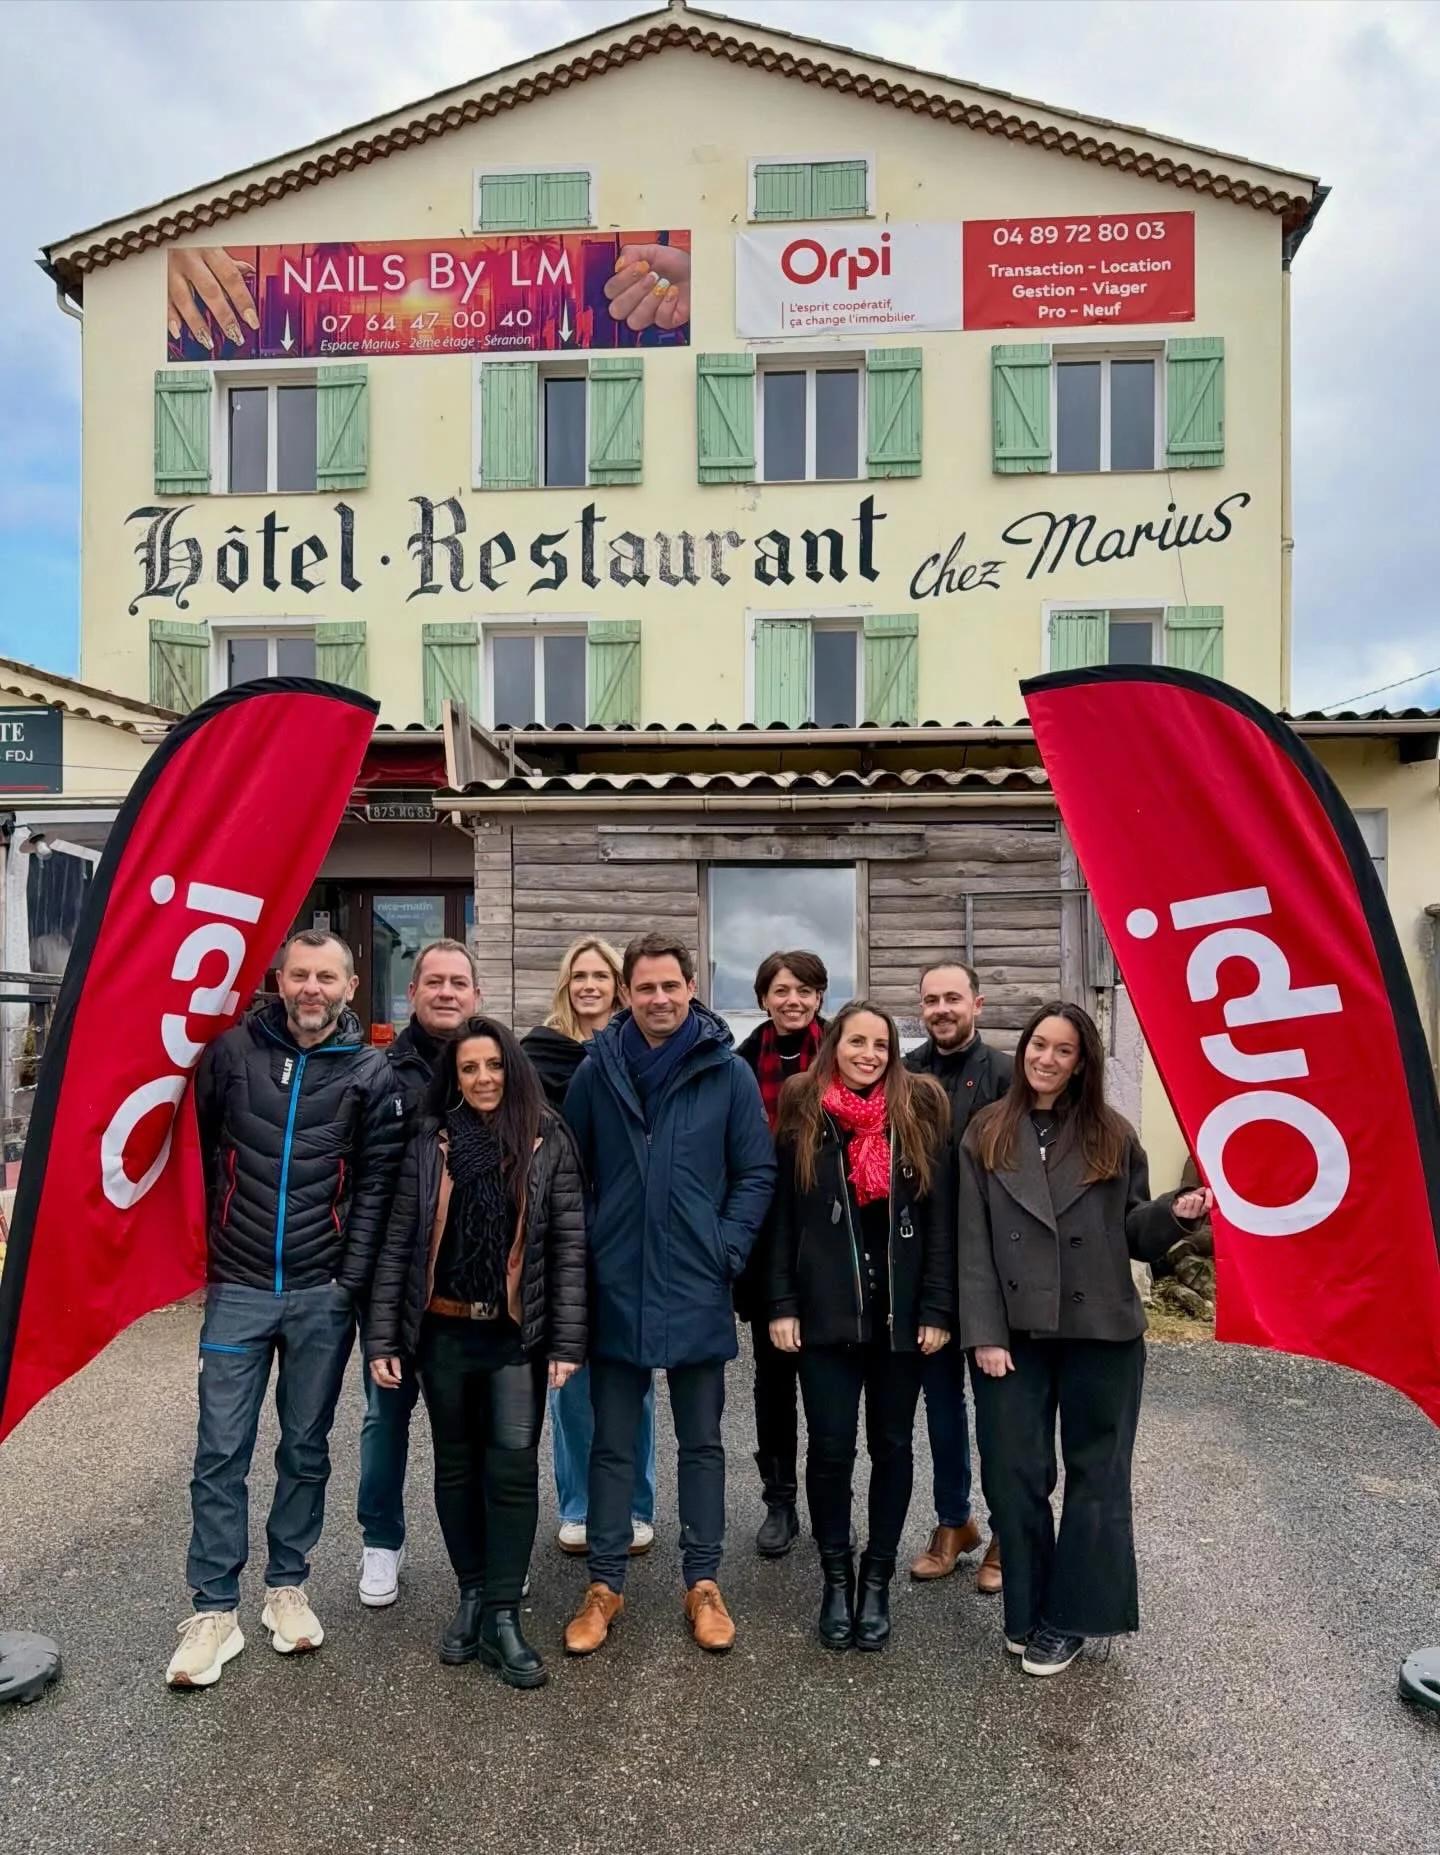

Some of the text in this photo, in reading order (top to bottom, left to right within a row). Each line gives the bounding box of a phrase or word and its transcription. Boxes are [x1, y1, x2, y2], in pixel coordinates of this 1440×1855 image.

[993, 221, 1166, 246] 04 89 72 80 03
[781, 232, 891, 290] Orpi
[988, 262, 1084, 277] Transaction
[1101, 259, 1172, 274] Location
[284, 249, 573, 304] NAILS By LM
[1012, 284, 1075, 298] Gestion
[1092, 281, 1148, 297] Viager
[789, 299, 893, 314] L'esprit coopératif,
[1038, 305, 1066, 319] Pro
[1083, 302, 1122, 317] Neuf
[321, 309, 533, 333] 07 64 47 00 40
[789, 318, 802, 329] ça
[805, 315, 846, 326] change
[320, 339, 360, 353] Espace
[360, 338, 401, 350] Marius
[442, 333, 475, 350] étage
[484, 333, 532, 346] Séranon
[124, 502, 362, 616] Hôtel
[406, 494, 888, 603] Restaurant
[5, 749, 34, 762] FDJ
[1126, 886, 1351, 1236] Orpi
